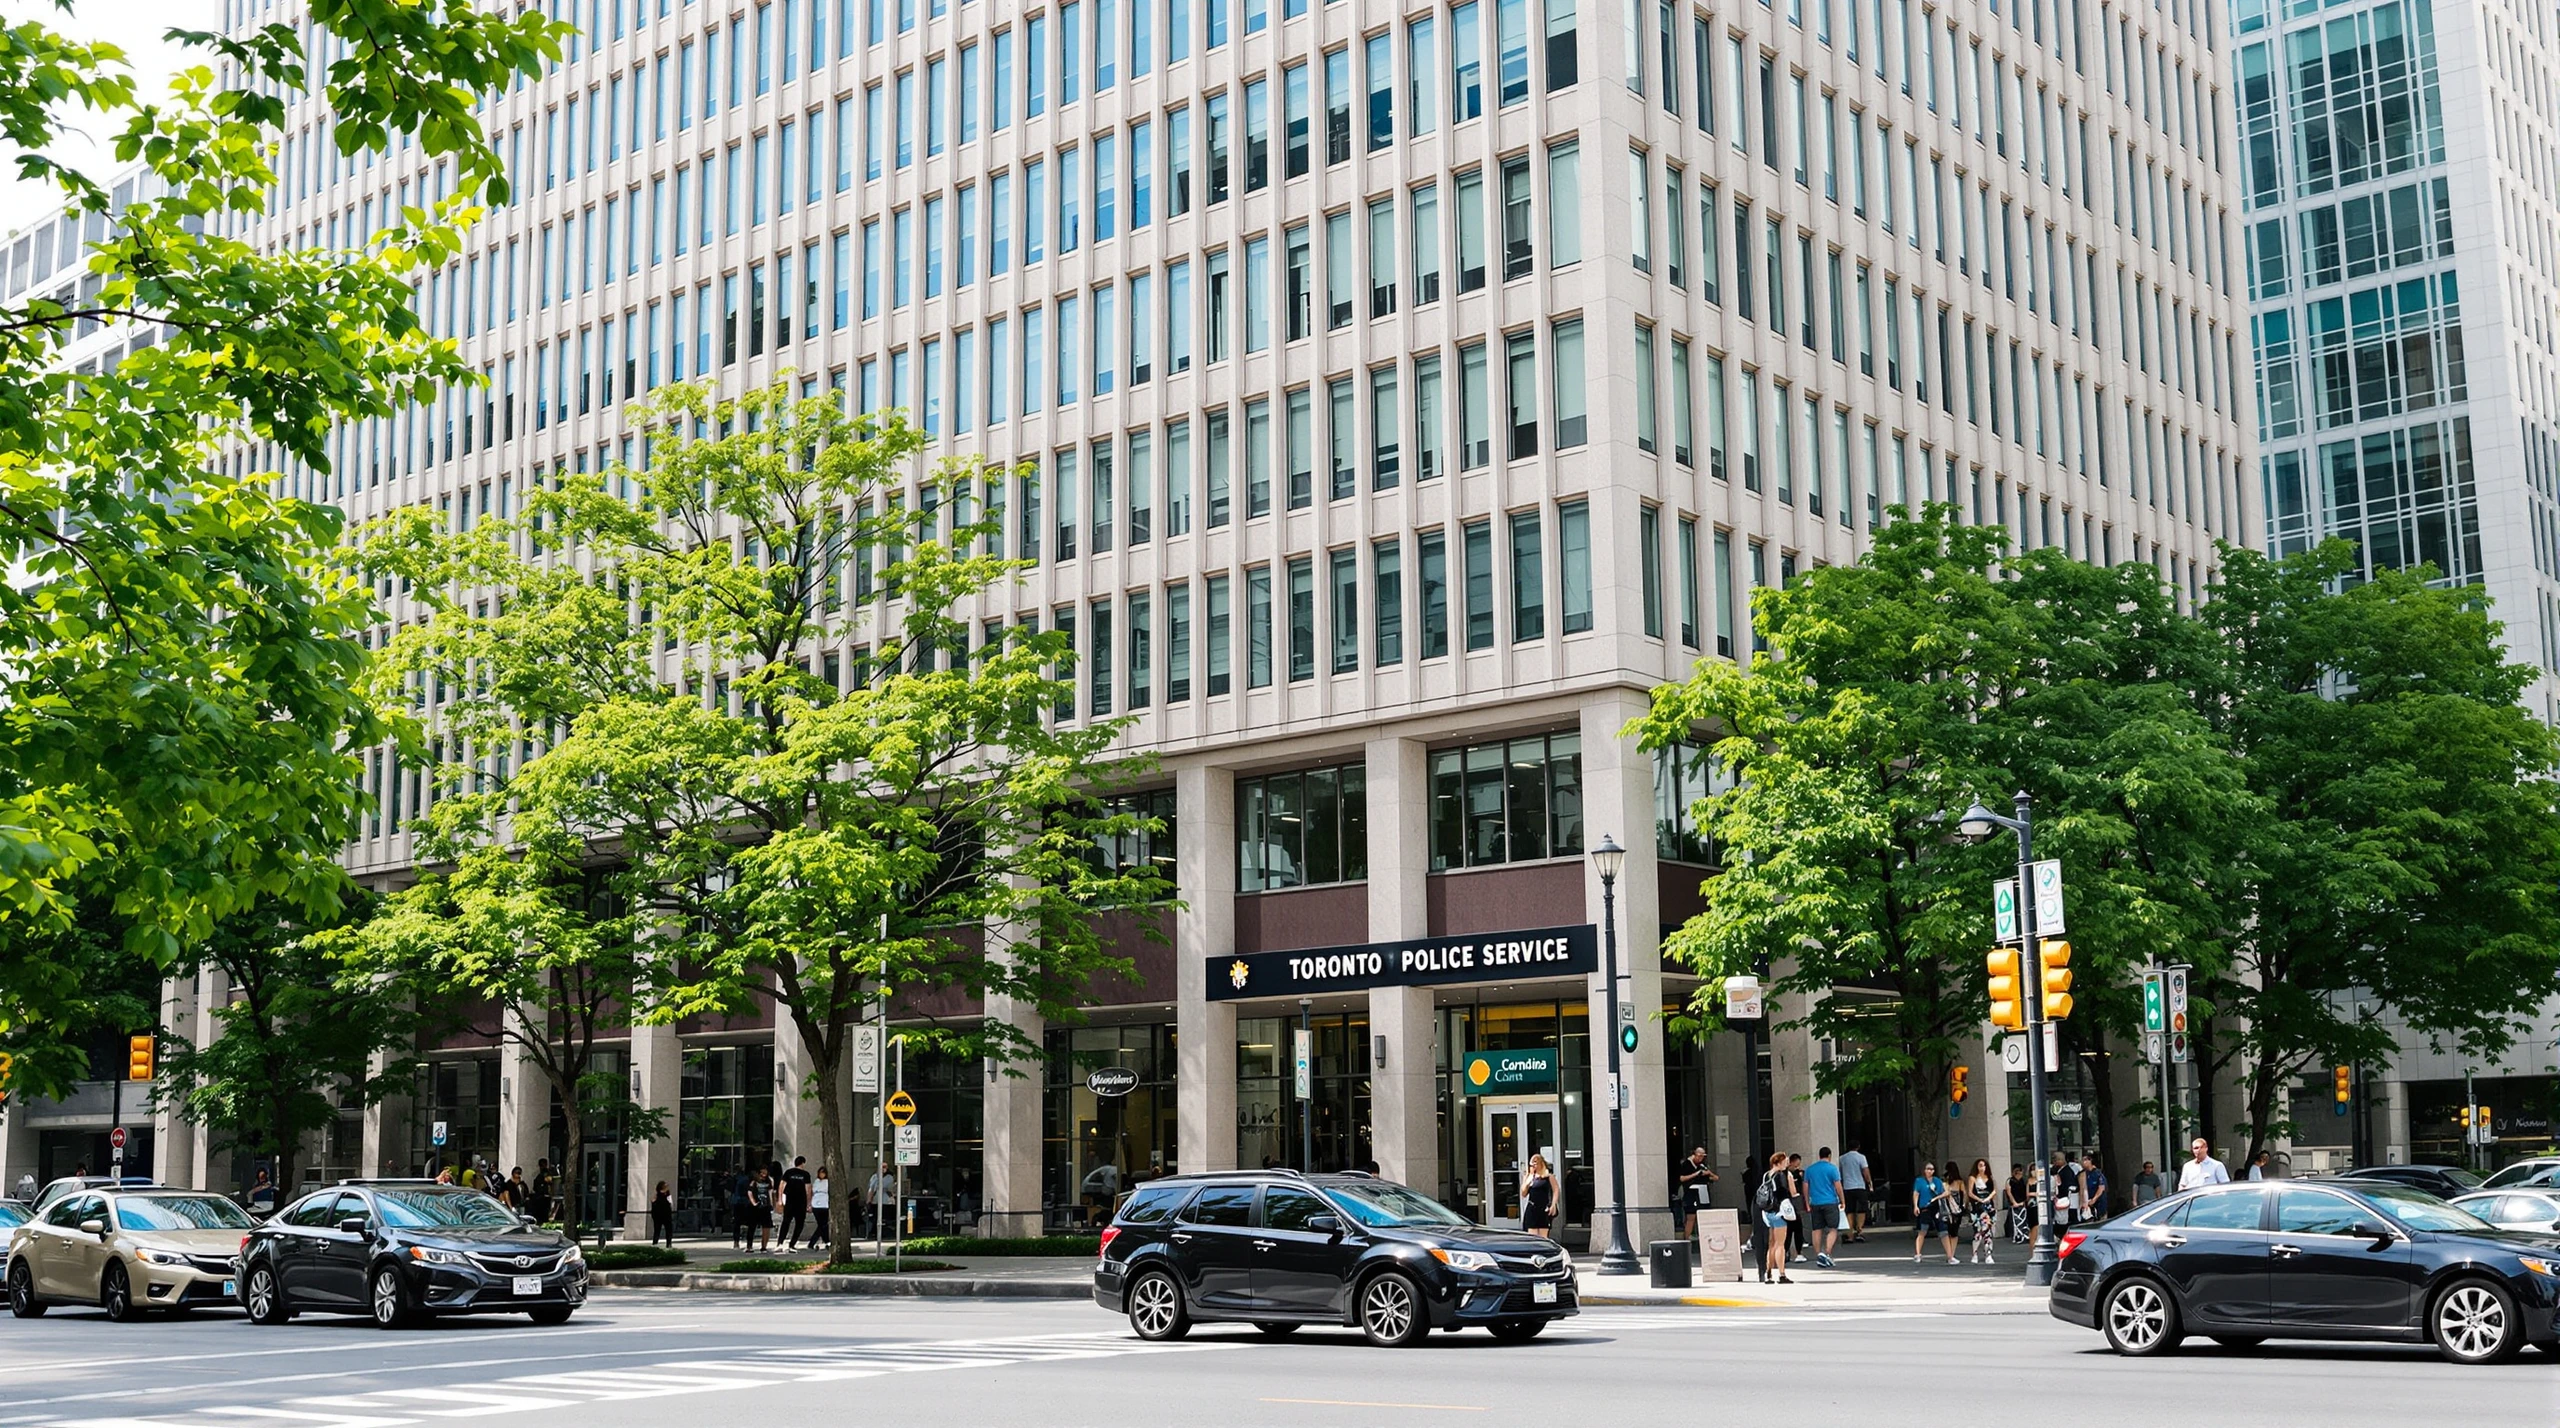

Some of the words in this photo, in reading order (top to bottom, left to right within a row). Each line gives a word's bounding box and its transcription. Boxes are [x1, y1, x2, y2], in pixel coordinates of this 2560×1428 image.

[1289, 952, 1382, 980] TORONTO
[1402, 945, 1475, 972] POLICE
[1483, 937, 1569, 966] SERVICE
